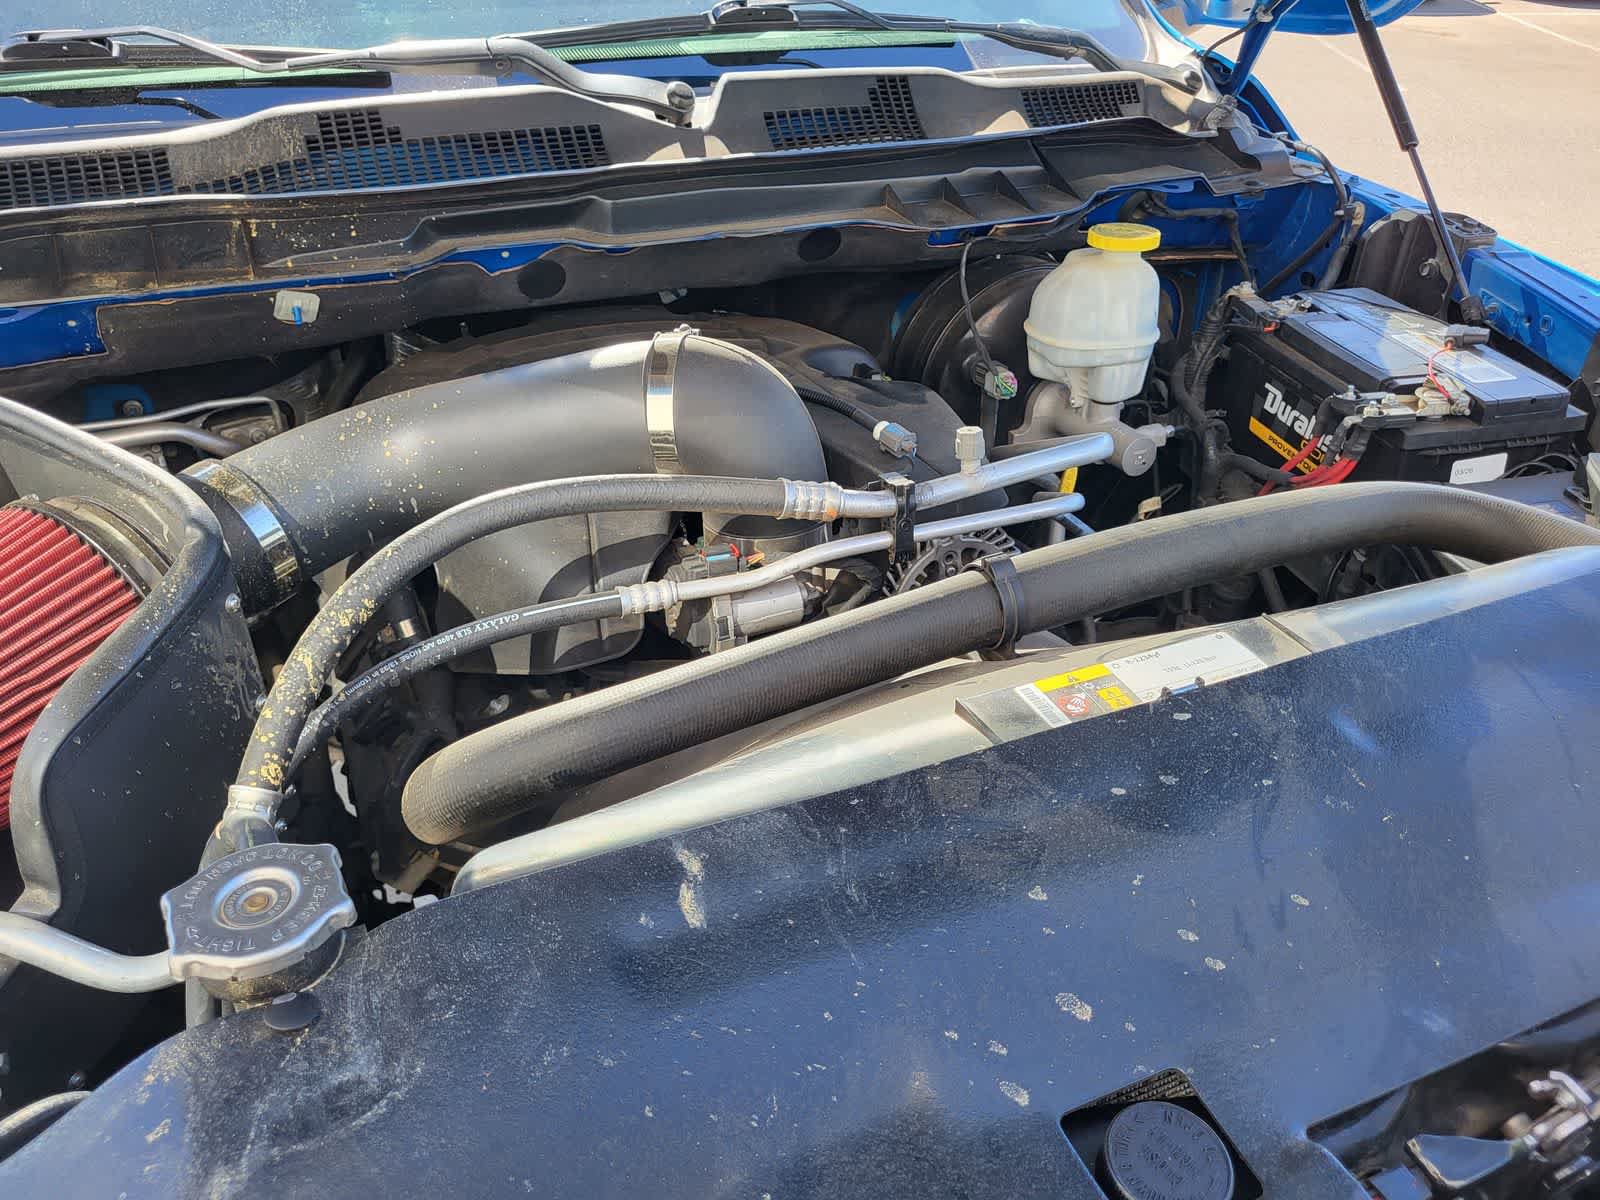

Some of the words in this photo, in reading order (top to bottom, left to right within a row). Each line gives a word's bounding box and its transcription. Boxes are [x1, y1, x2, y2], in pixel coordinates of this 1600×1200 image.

[474, 613, 520, 633] GALAXY
[399, 647, 422, 663] HOSE
[344, 675, 372, 696] (10mm)
